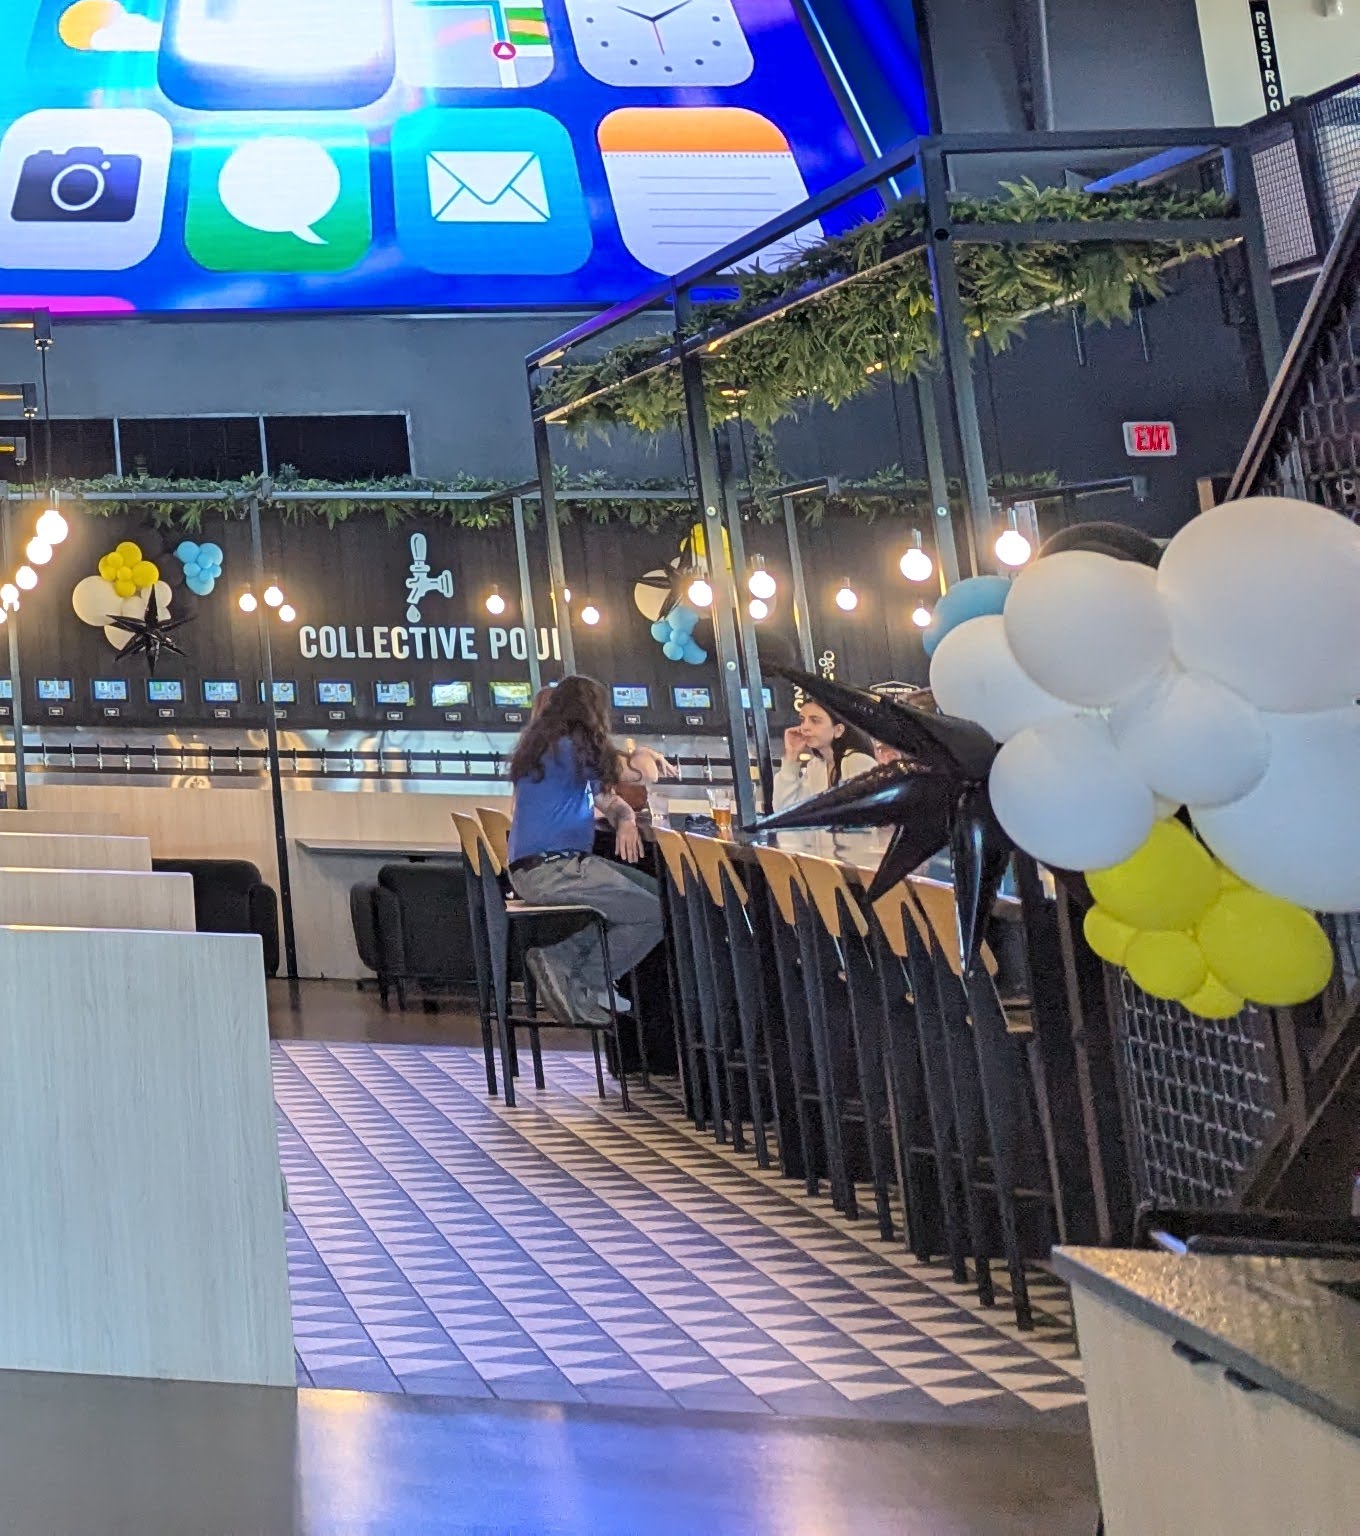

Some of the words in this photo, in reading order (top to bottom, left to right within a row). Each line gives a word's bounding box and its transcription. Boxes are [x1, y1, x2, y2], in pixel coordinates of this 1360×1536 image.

[1254, 11, 1281, 112] RESTROO
[1135, 425, 1170, 451] EXIT
[299, 625, 479, 661] COLLECTIVE
